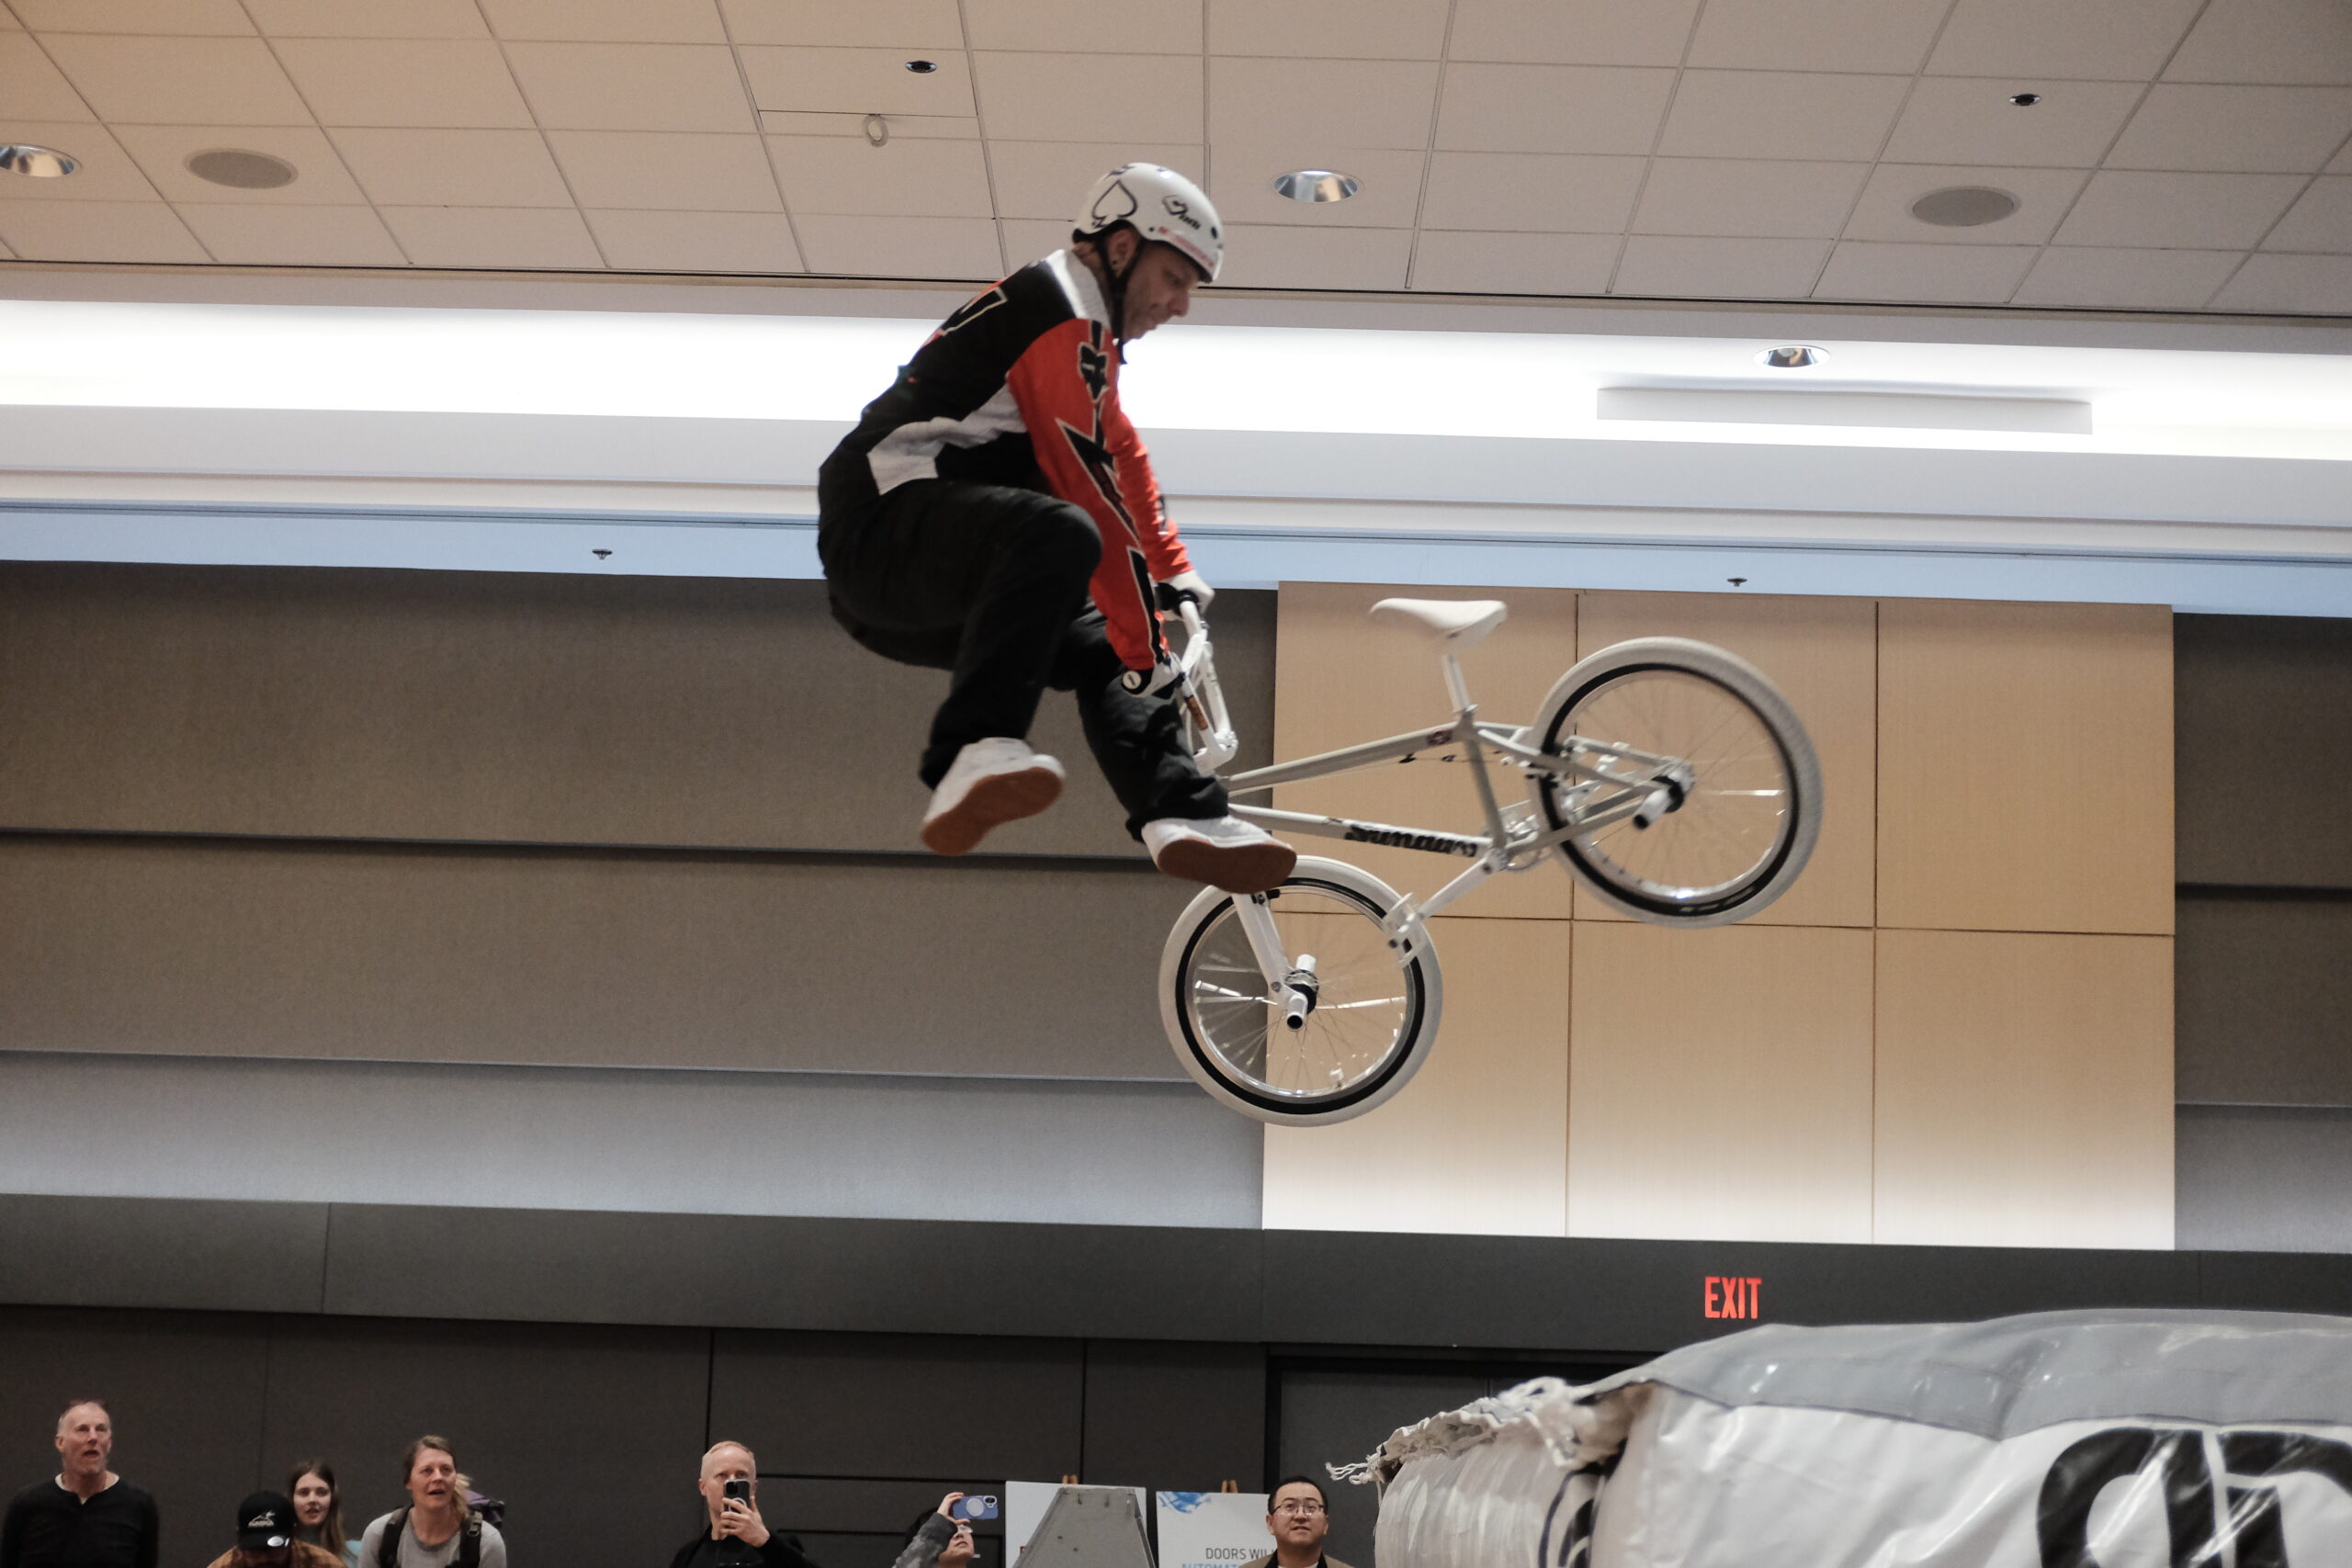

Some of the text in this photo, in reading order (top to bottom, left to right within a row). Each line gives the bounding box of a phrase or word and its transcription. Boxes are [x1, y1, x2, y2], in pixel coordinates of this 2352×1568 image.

[1704, 1276, 1762, 1319] EXIT
[1205, 1547, 1274, 1560] DOORS WI
